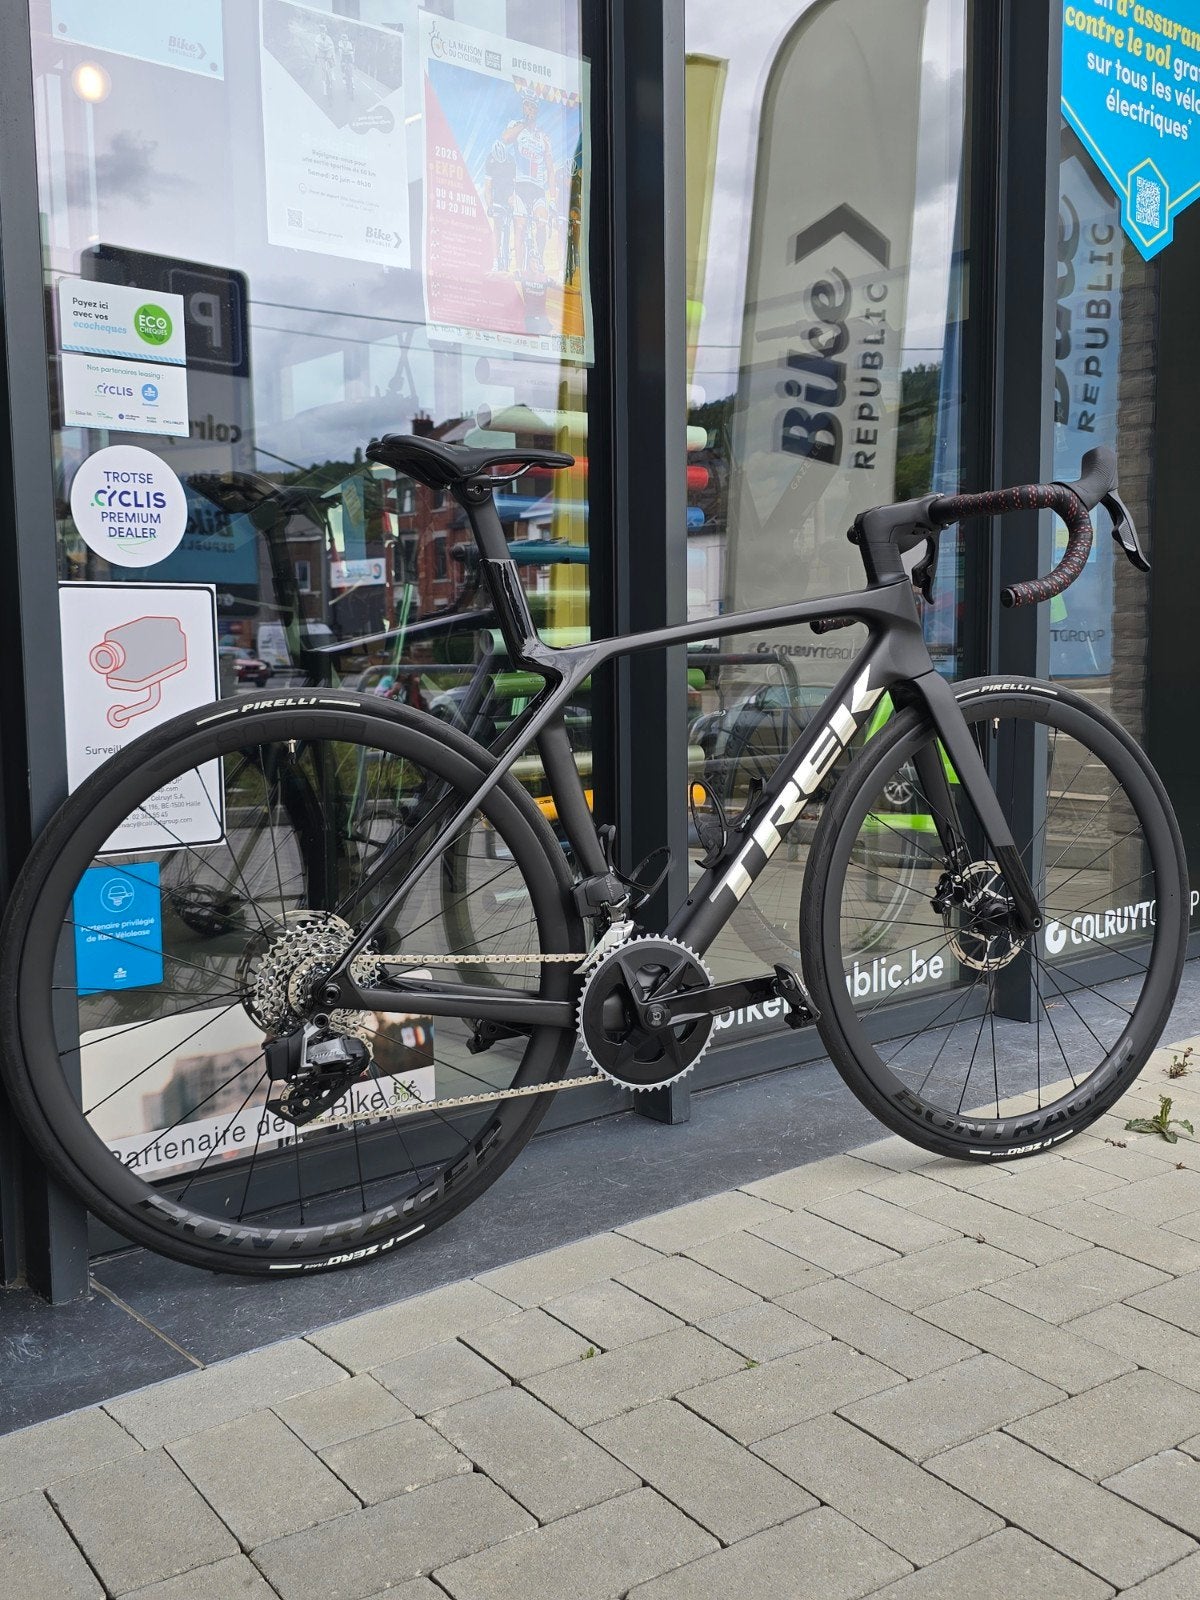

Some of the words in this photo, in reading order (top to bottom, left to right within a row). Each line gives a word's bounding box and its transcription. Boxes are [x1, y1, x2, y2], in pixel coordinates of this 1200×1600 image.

[448, 39, 457, 49] LA
[1065, 6, 1124, 48] contre
[1127, 27, 1143, 57] le
[1146, 44, 1171, 70] vol
[1173, 57, 1200, 83] gra
[448, 49, 456, 58] DU
[512, 56, 552, 77] présente
[1087, 52, 1112, 76] sur
[1115, 59, 1148, 92] tous
[1151, 71, 1172, 102] les
[436, 188, 446, 198] DU
[448, 190, 454, 199] 4
[456, 191, 477, 206] AVRIL
[436, 199, 446, 210] AU
[448, 202, 459, 214] 20
[461, 204, 477, 218] JUIN
[365, 226, 393, 243] Bike
[72, 297, 97, 310] Payez
[99, 301, 109, 310] ici
[72, 310, 93, 320] avec
[94, 312, 109, 321] vos
[138, 314, 167, 328] ECO
[73, 320, 128, 335] ecocheques
[140, 326, 168, 336] CHEQUES
[1077, 223, 1115, 433] REPUBLIC
[86, 364, 100, 372] Nos
[100, 366, 138, 377] partenaires
[138, 369, 160, 380] leasing
[776, 265, 851, 466] Bike
[854, 282, 889, 470] REPUBLIC
[104, 471, 154, 484] TROTSE
[92, 485, 167, 509] CYCLIS
[101, 511, 162, 524] PREMIUM
[108, 526, 157, 539] DEALER
[980, 683, 1031, 693] PIRELLI
[241, 697, 317, 713] PIRELLI
[709, 663, 885, 902] TREK
[121, 917, 154, 929] privilégié
[86, 934, 97, 943] de
[114, 928, 151, 939] Vélolease
[256, 1113, 286, 1137] de
[1007, 1144, 1044, 1156] ZERO
[1043, 1138, 1052, 1148] P
[381, 1238, 395, 1250] P
[327, 1244, 380, 1266] ZERO
